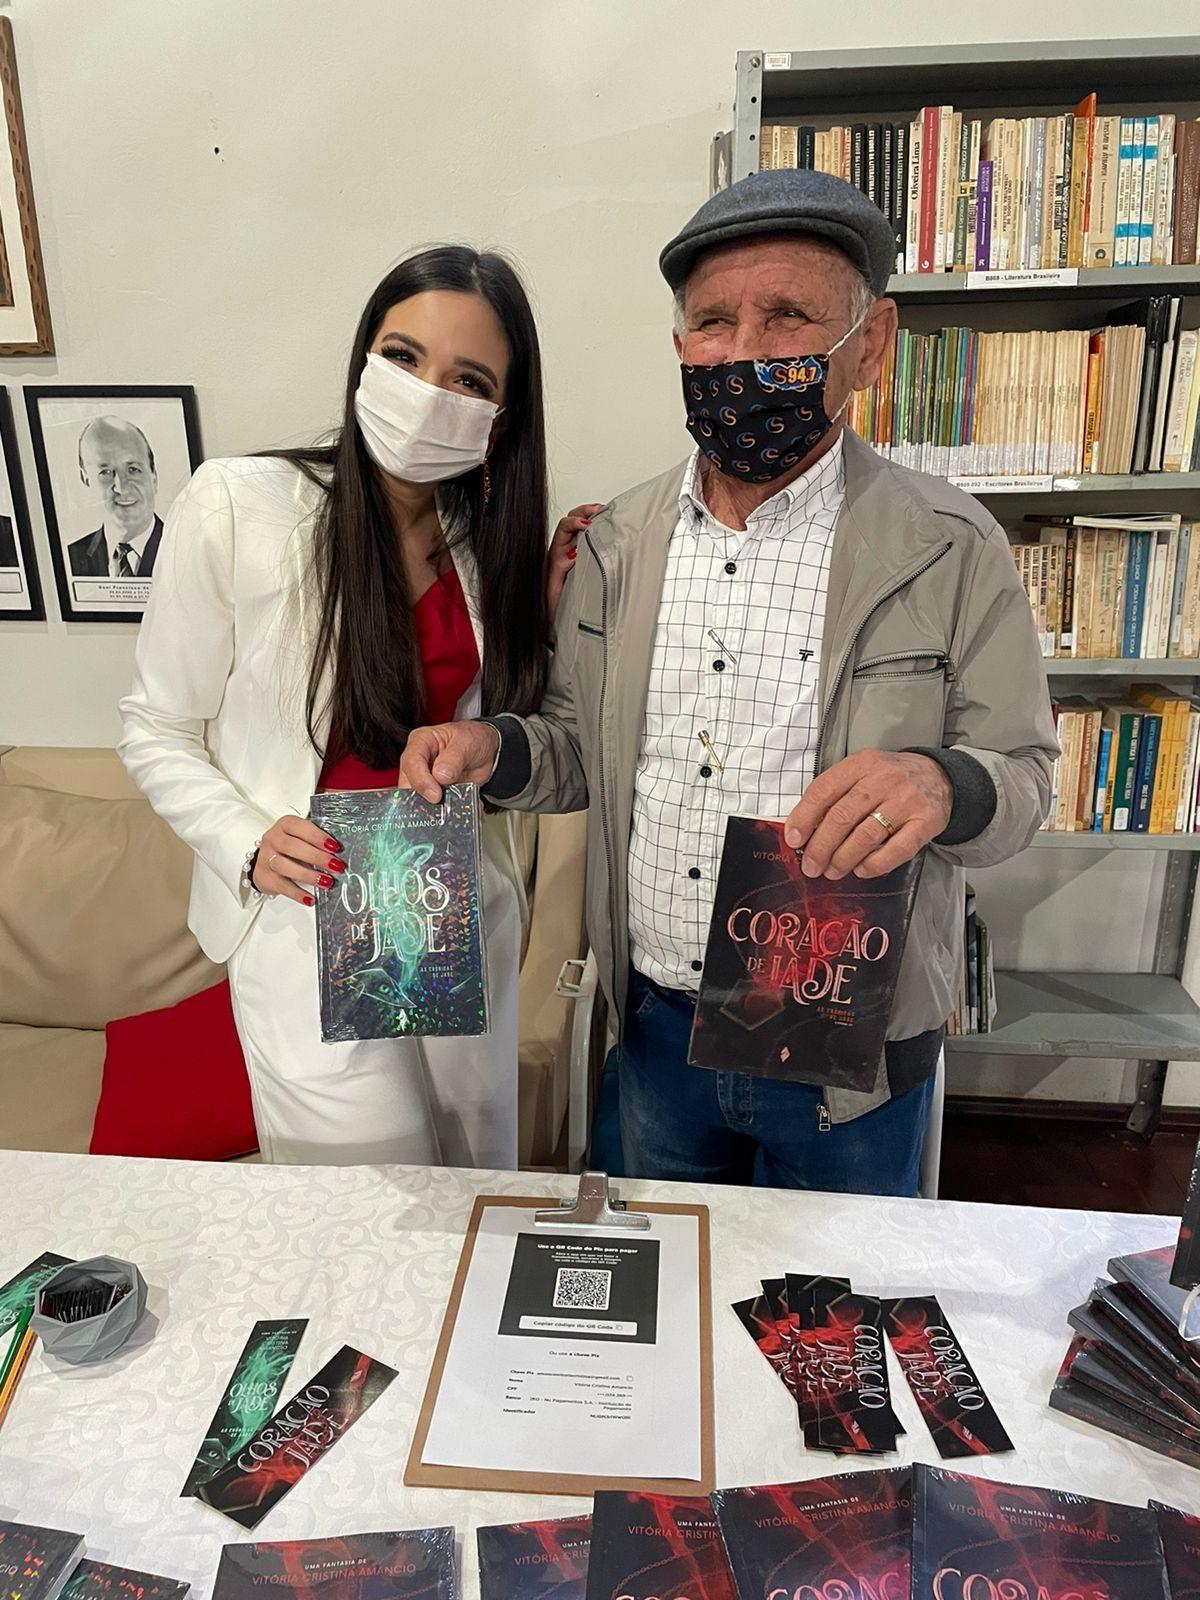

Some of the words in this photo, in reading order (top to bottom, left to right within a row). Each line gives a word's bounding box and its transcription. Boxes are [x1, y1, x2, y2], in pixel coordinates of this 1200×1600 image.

[913, 141, 922, 165] Lima
[960, 150, 968, 182] COUTINHO
[911, 166, 921, 200] Oliveira
[788, 366, 817, 384] 94.7
[340, 823, 370, 834] VITÓRIA
[371, 818, 407, 832] CRISTINA
[407, 815, 443, 829] AMANCIO
[753, 850, 790, 864] VITÓRIA
[341, 866, 450, 915] OLHOS
[351, 922, 368, 942] DE
[365, 911, 446, 965] JADE
[727, 907, 890, 963] CORAÇÃO
[747, 956, 766, 974] DE
[554, 1322, 576, 1330] código
[853, 1324, 887, 1410] CORAÇÃO
[923, 1325, 985, 1411] CORAÇÃO
[230, 1382, 278, 1399] OLHOS
[237, 1385, 330, 1473] CORAÇÃO
[754, 1513, 799, 1529] VITÓRIA
[805, 1505, 854, 1522] CRISTINA
[856, 1498, 911, 1514] AMANCIO
[800, 1503, 816, 1513] UMA
[817, 1498, 849, 1508] FANTASIA
[1000, 1505, 1017, 1513] UMA
[1019, 1508, 1054, 1518] FANTASIA
[627, 1523, 672, 1538] VITÓRIA
[948, 1502, 997, 1522] VITÓRIA
[1001, 1513, 1056, 1532] CRISTINA
[1058, 1521, 1121, 1544] AMANCIO
[562, 1541, 574, 1549] UMA
[322, 1558, 356, 1569] FANTASIA
[357, 1556, 367, 1564] DE
[514, 1550, 560, 1567] VITÓRIA
[251, 1571, 297, 1586] VITÓRIA
[306, 1567, 356, 1582] CRISTINA
[357, 1563, 417, 1579] AMANCIO
